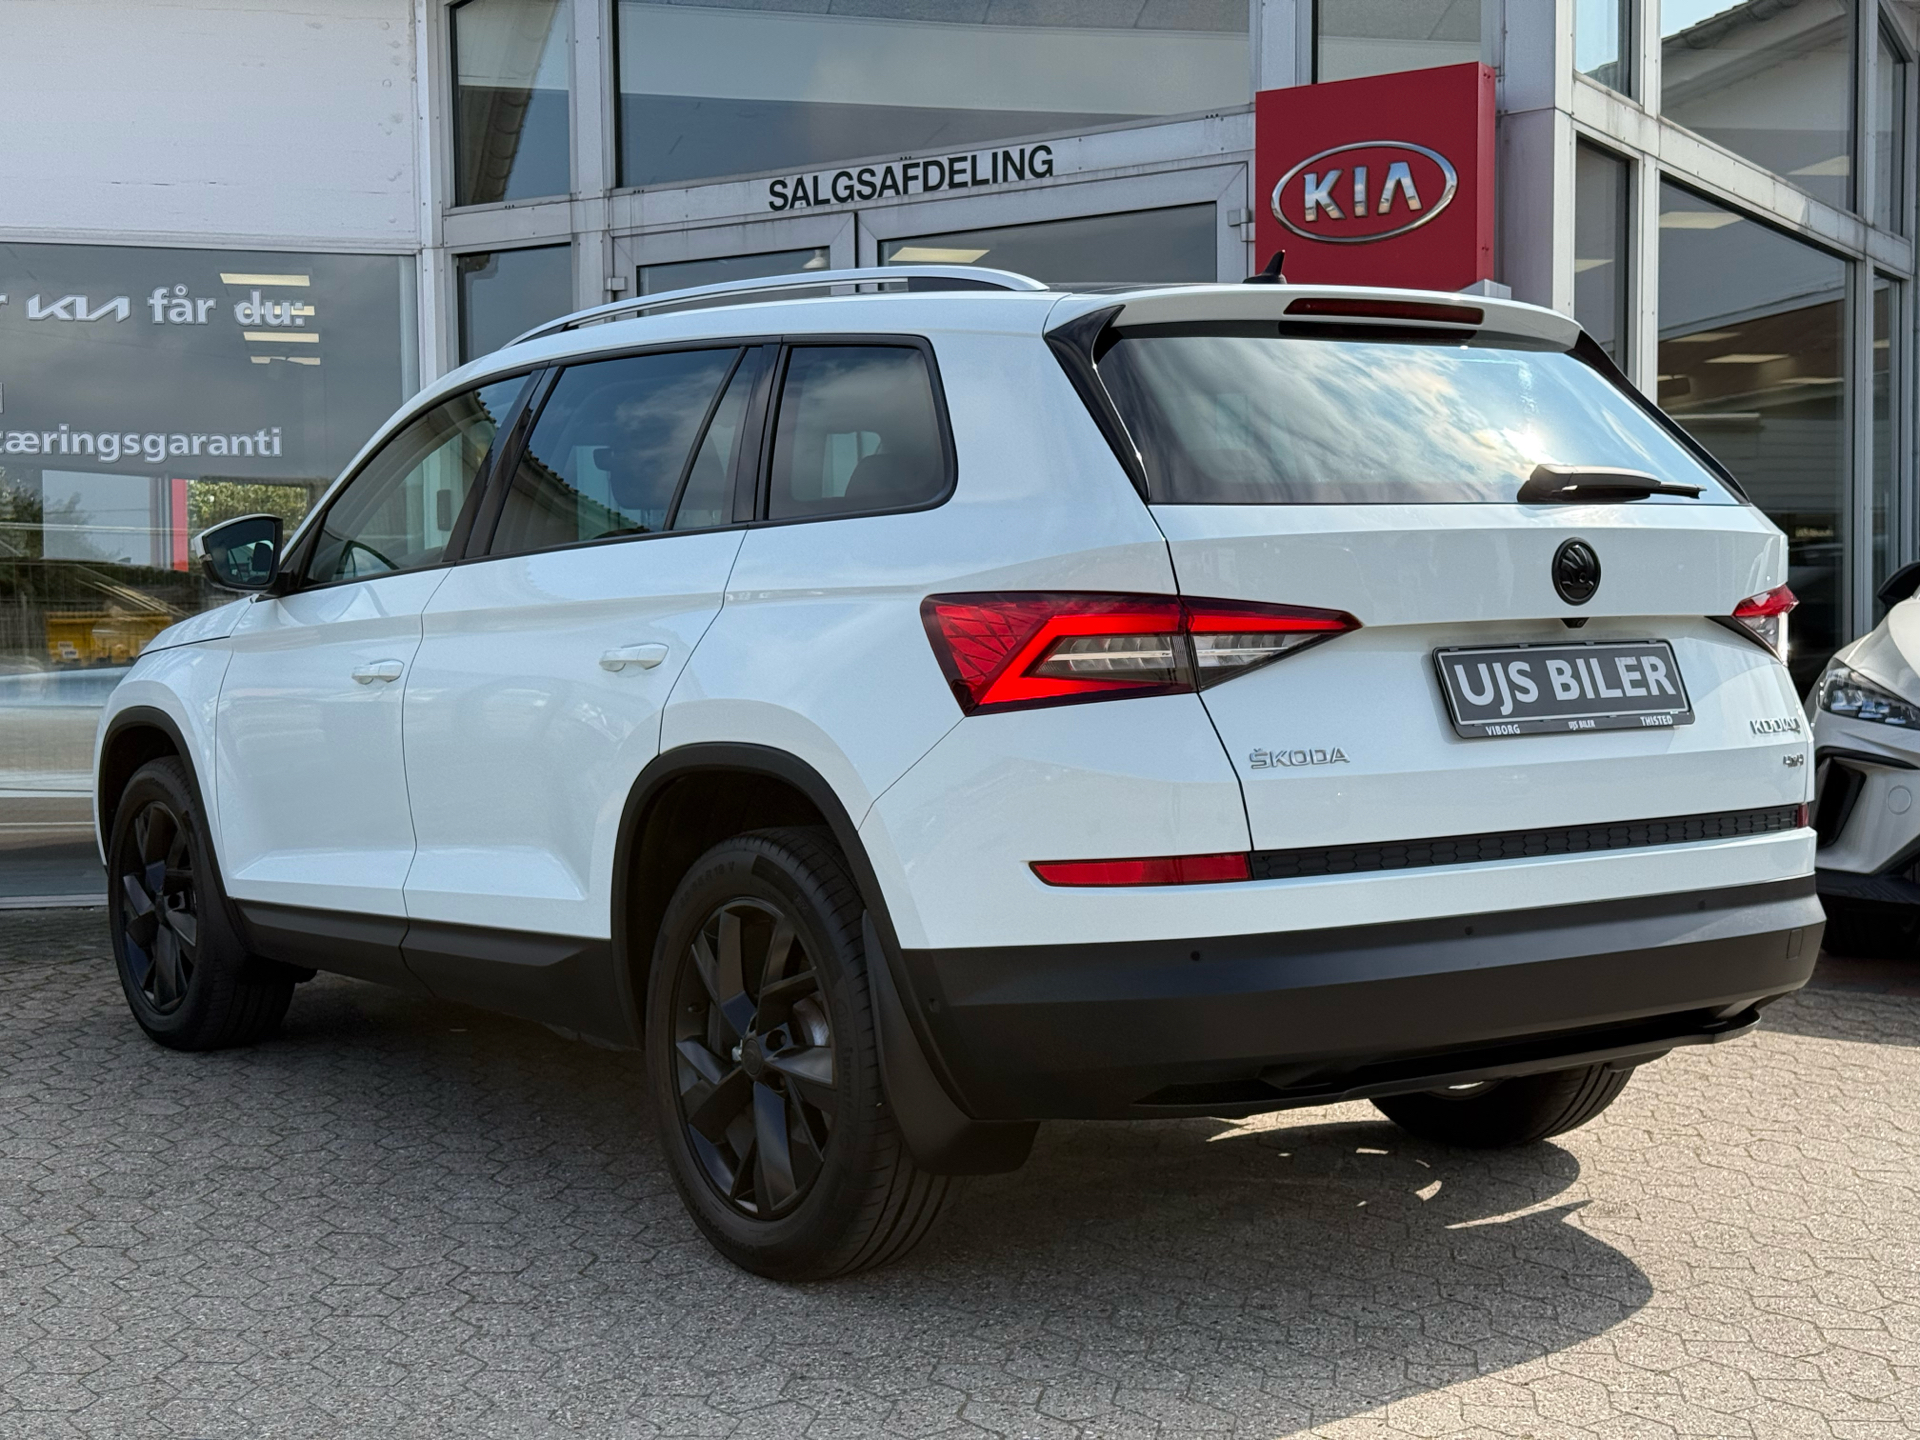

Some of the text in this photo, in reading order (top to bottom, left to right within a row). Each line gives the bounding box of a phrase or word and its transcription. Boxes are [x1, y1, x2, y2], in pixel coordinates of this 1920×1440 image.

[768, 144, 1054, 212] SALGSAFDELING
[1303, 161, 1423, 223] KIA
[147, 284, 216, 325] får
[234, 289, 305, 327] du:
[0, 423, 283, 463] æringsgaranti
[1453, 655, 1677, 715] UJS BILER
[1485, 724, 1521, 736] VIBORG
[1578, 719, 1596, 729] BILER
[1640, 715, 1673, 726] THISTED
[1248, 747, 1351, 770] ŠKODA
